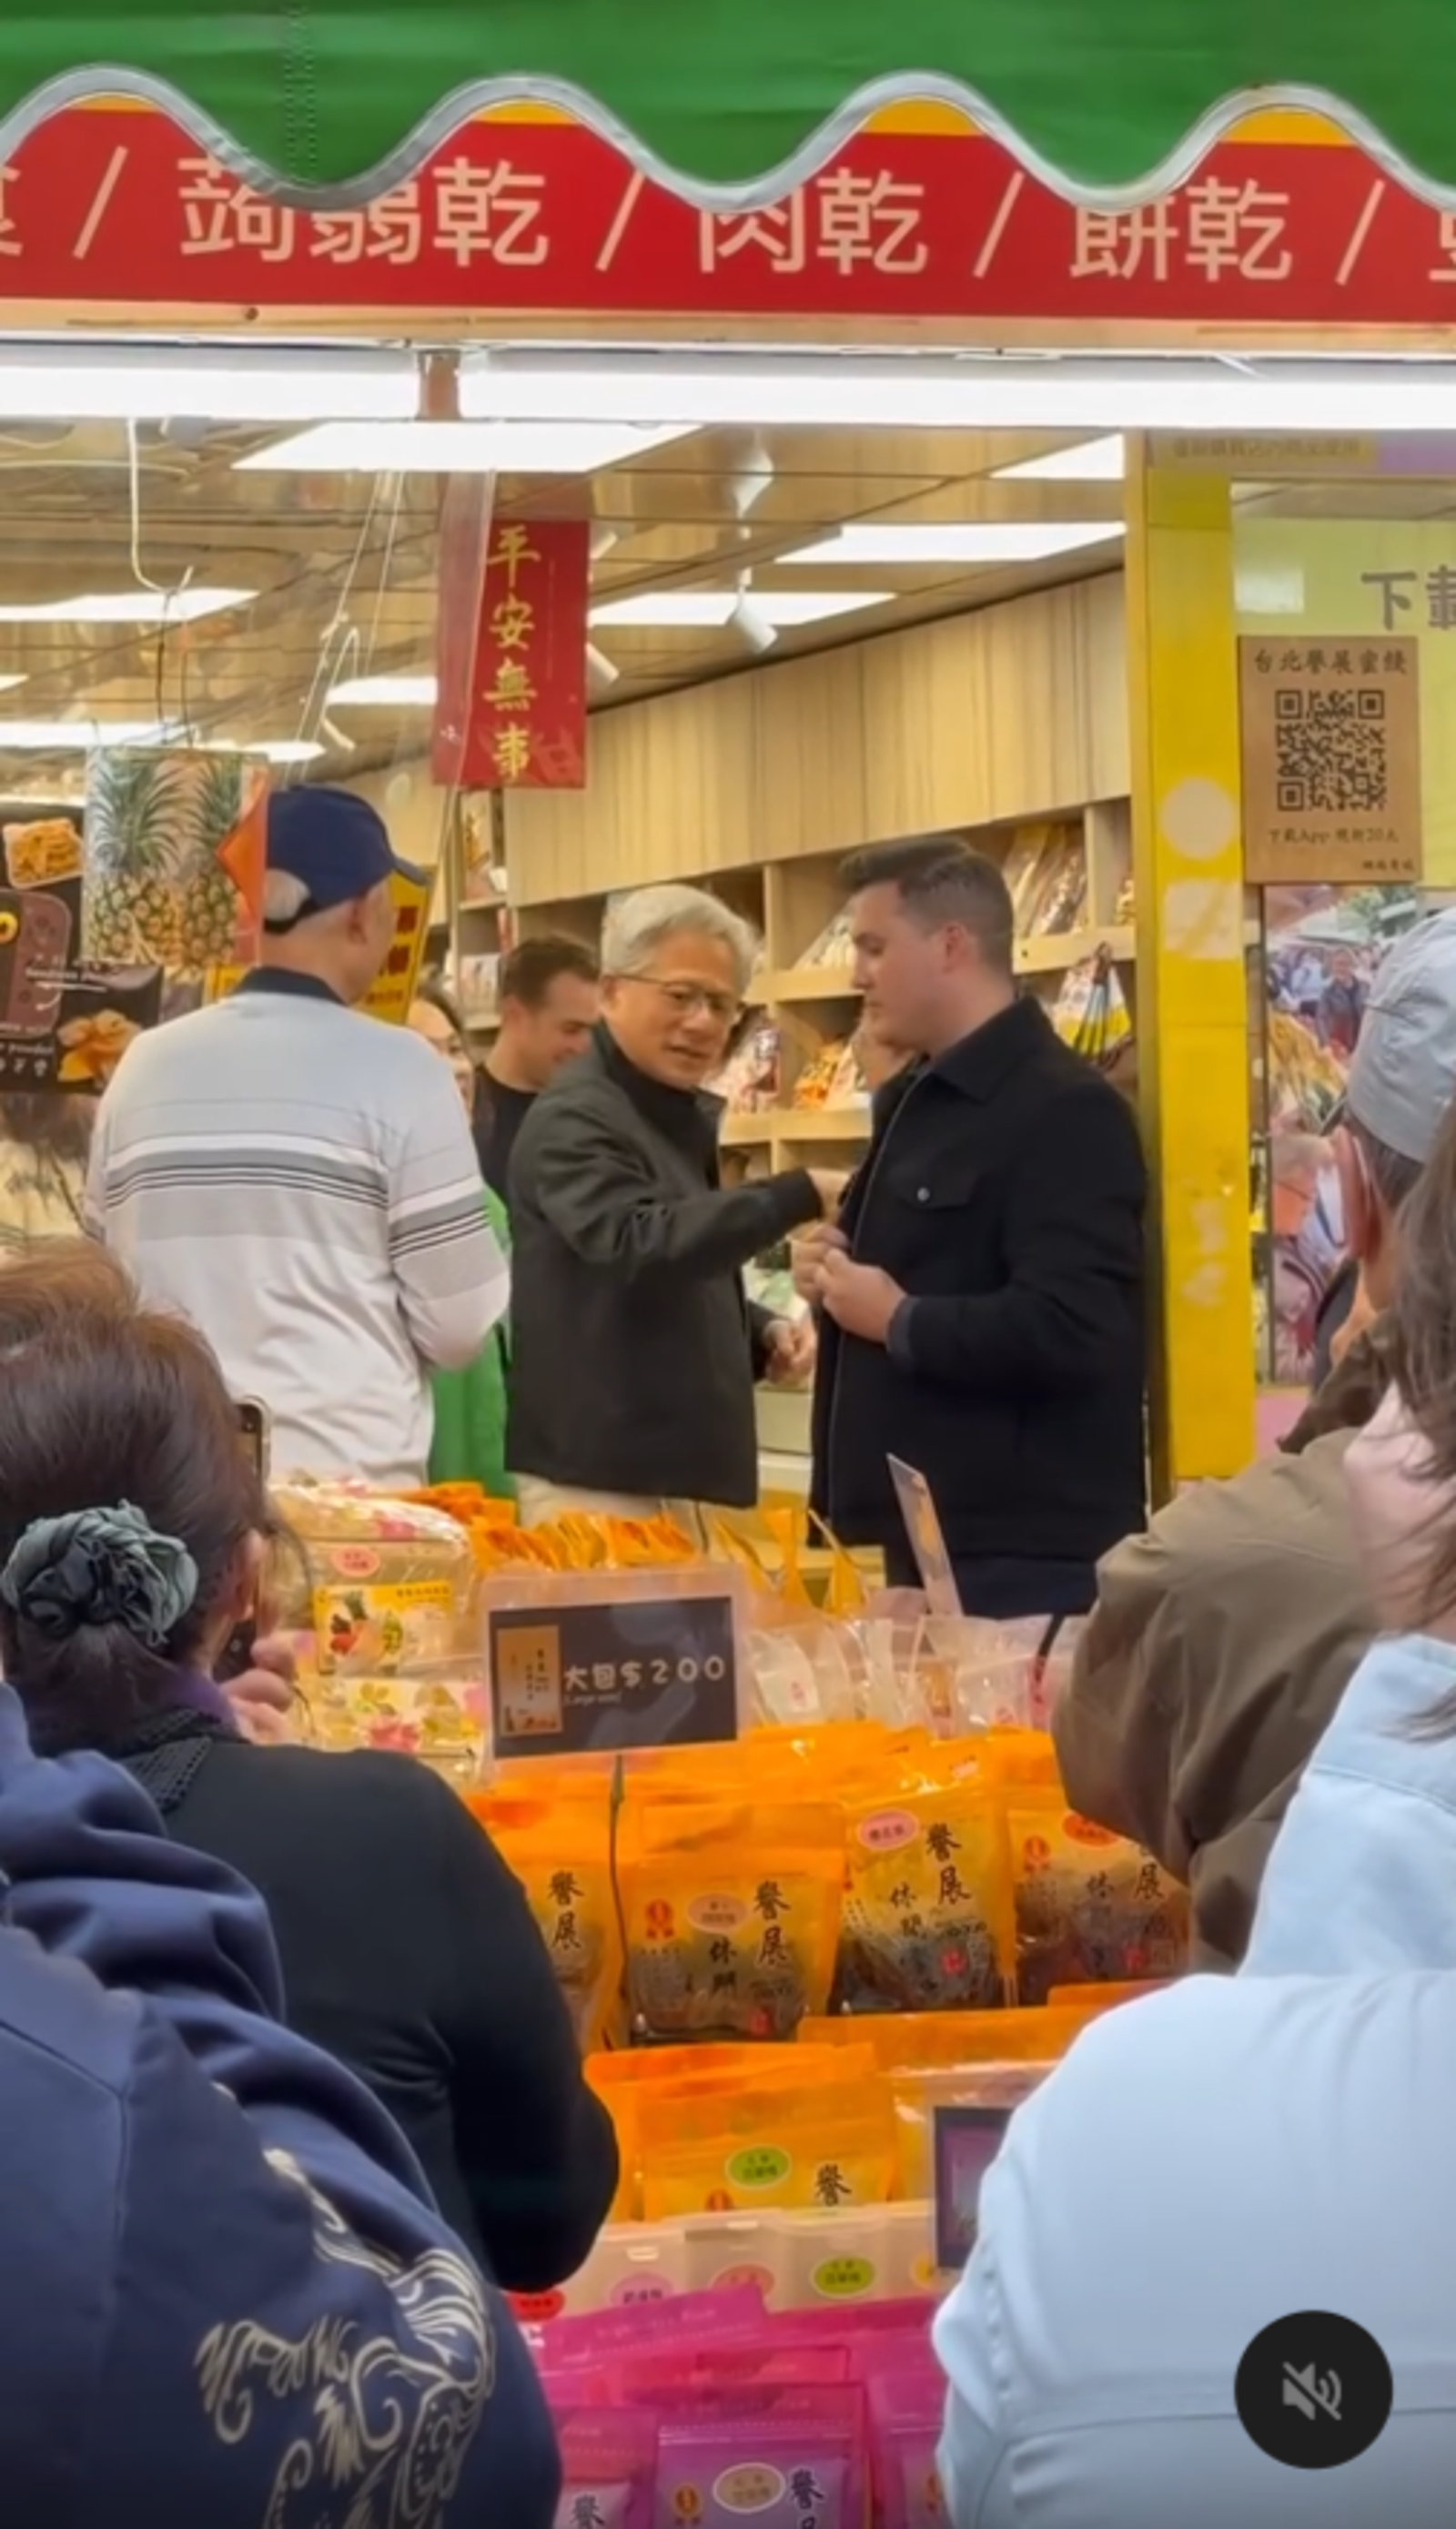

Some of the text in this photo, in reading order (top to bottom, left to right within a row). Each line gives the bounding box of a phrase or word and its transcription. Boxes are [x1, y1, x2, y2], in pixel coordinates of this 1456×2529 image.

[699, 167, 929, 277] 肉乾
[1069, 177, 1294, 282] 餅乾
[483, 524, 541, 779] 平安無事
